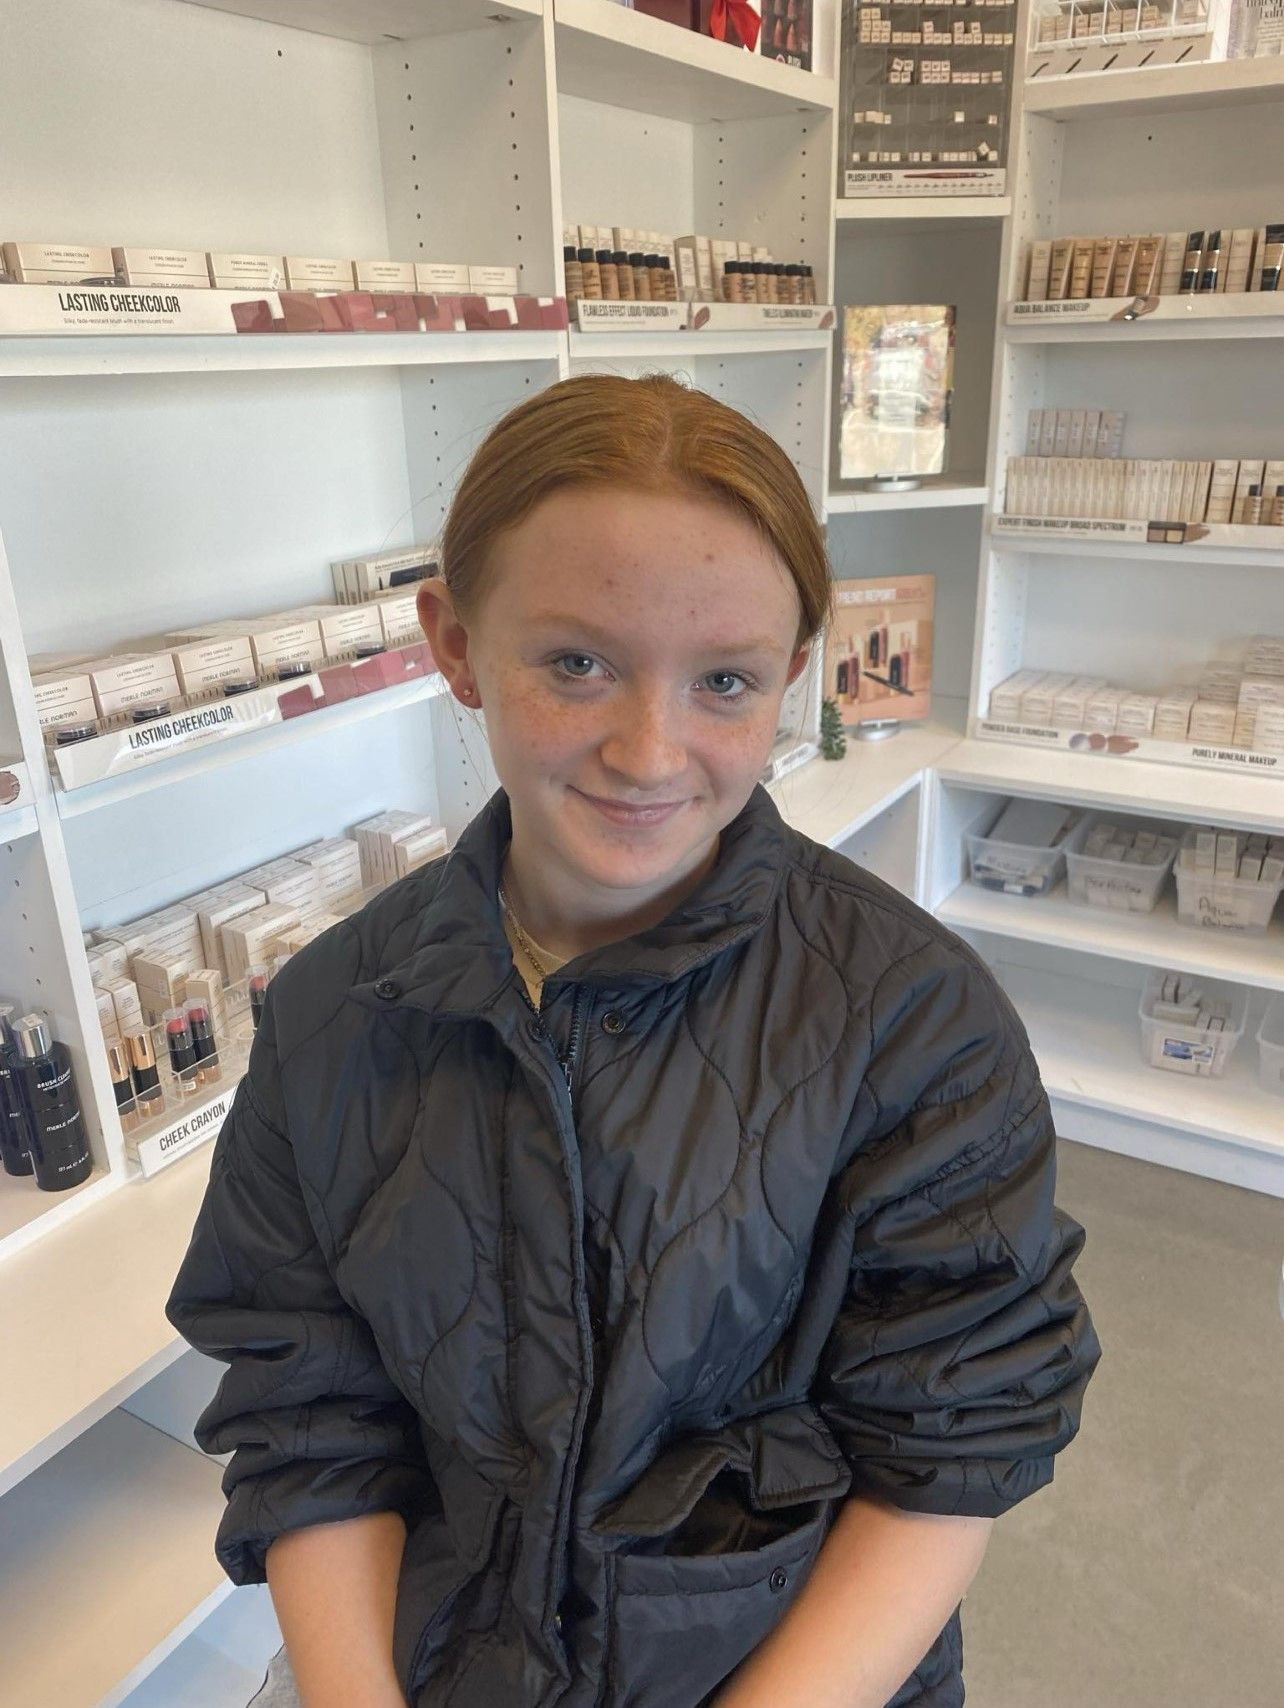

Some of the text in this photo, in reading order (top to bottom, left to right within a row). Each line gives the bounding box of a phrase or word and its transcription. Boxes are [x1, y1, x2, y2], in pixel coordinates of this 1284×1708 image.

[58, 293, 181, 313] LASTING CHEEKCOLOR
[129, 705, 234, 750] LASTING CHEEKCOLOR
[1192, 747, 1278, 766] PURELY MINERAL MAKEUP
[37, 1078, 57, 1089] BRUSH
[46, 1122, 67, 1132] MERLE
[159, 1101, 226, 1151] CHEEK CRAYON
